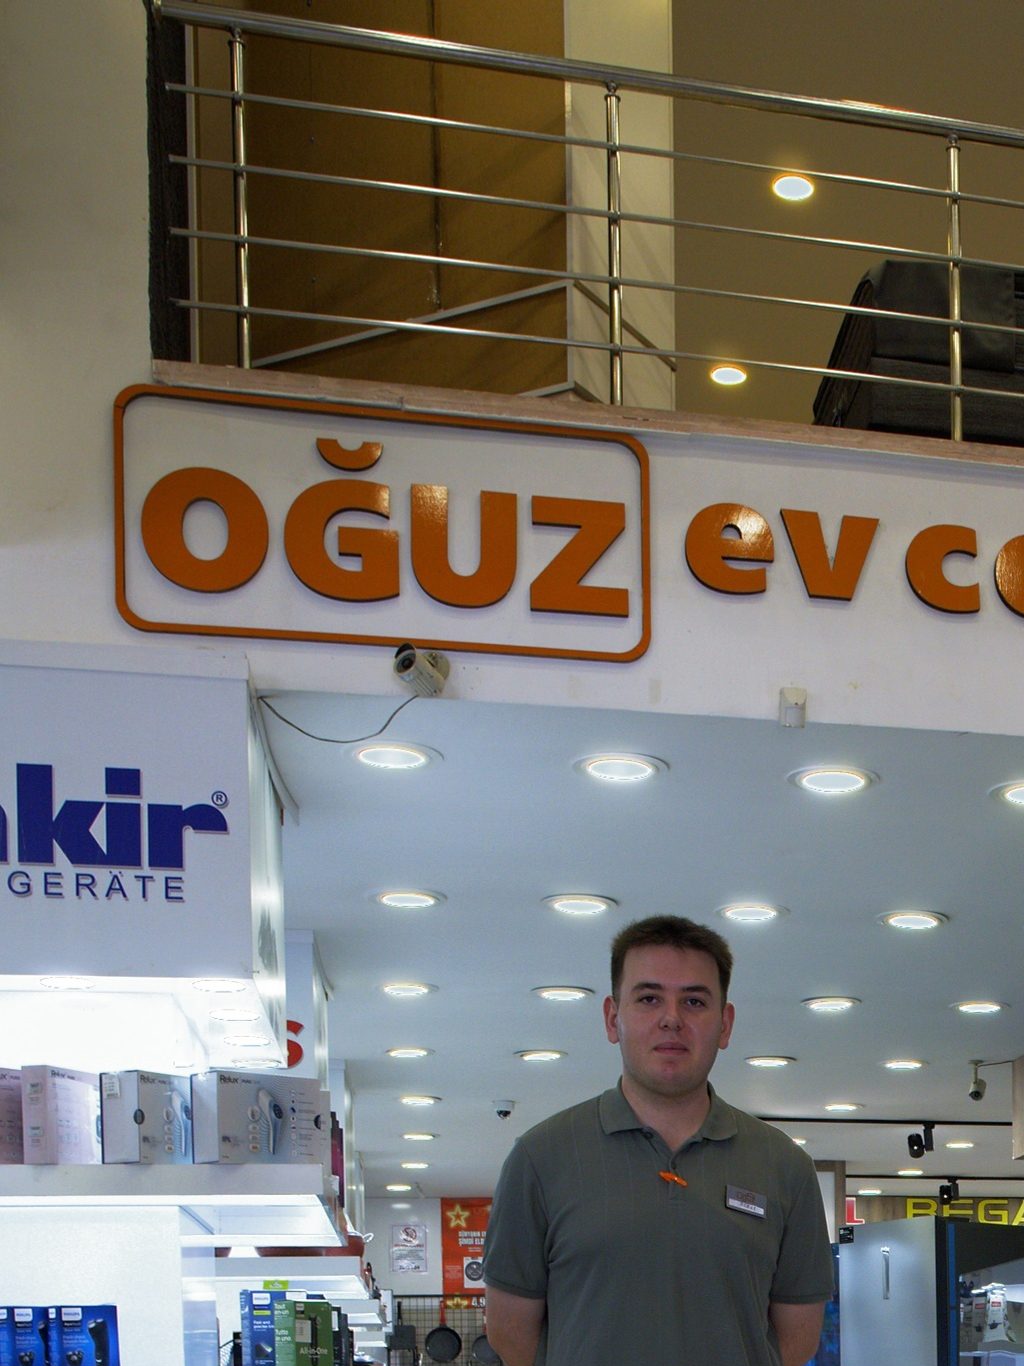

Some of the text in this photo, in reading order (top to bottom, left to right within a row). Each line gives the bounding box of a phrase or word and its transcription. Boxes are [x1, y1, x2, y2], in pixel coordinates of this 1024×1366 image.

[141, 438, 629, 618] OĞUZ
[685, 502, 880, 602] ev
[0, 763, 228, 869] kir
[7, 870, 186, 902] GERÄTE
[220, 1074, 239, 1085] Relux
